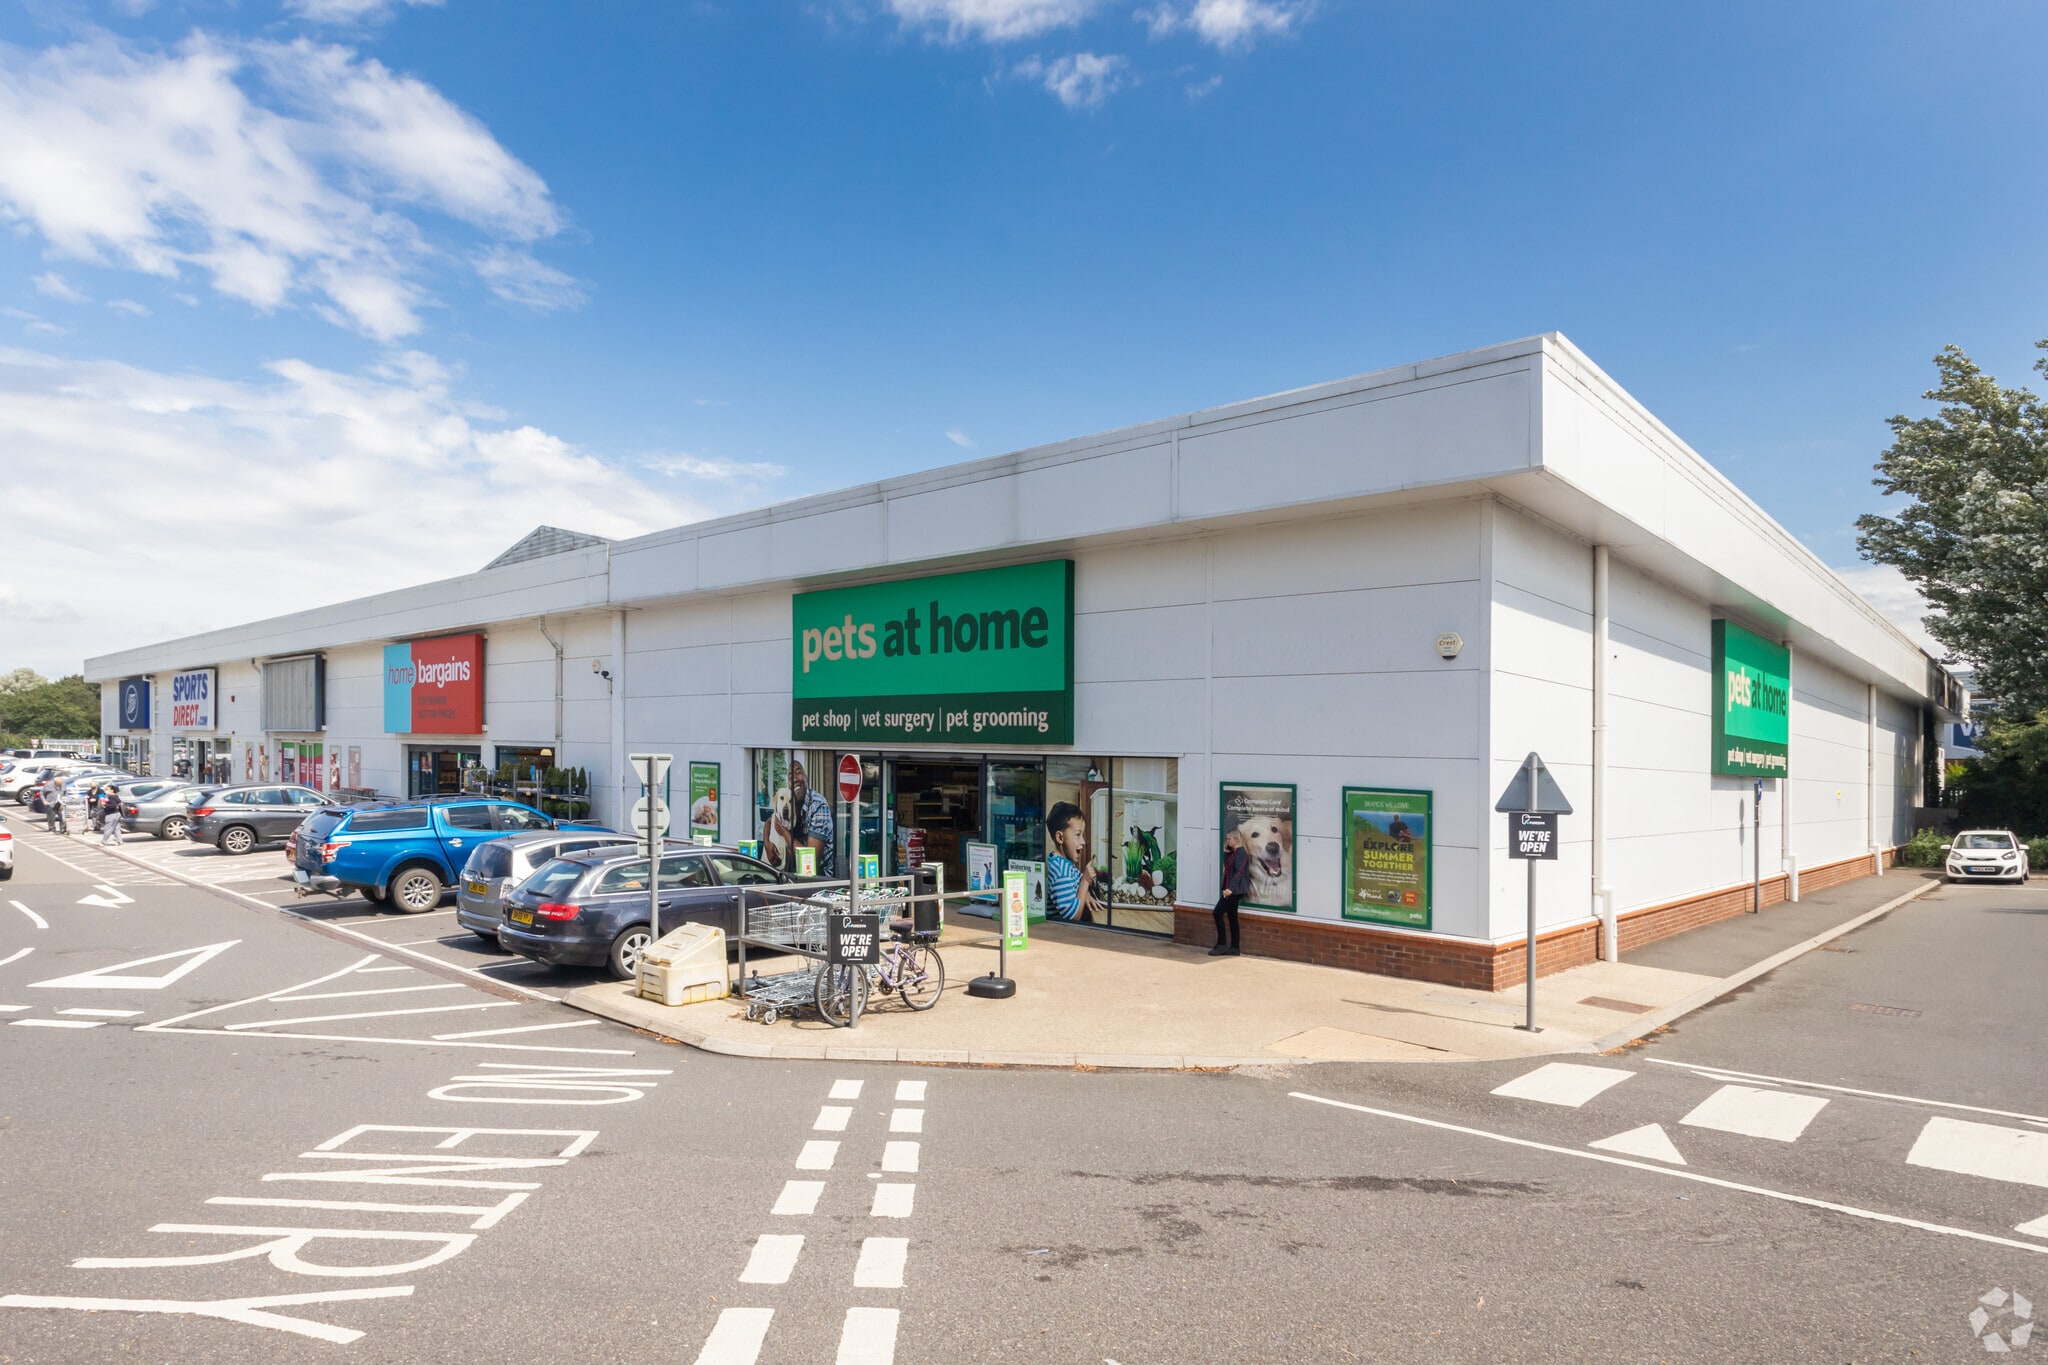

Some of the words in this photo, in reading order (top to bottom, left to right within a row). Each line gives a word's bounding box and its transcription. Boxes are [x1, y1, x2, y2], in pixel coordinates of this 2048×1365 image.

[802, 614, 877, 674] pets
[883, 607, 921, 657] at
[930, 600, 1049, 654] home
[387, 663, 414, 685] home
[418, 656, 471, 688] bargains
[173, 673, 208, 702] SPORTS
[1727, 666, 1751, 712] pets
[1751, 673, 1761, 709] at
[1762, 671, 1786, 717] home
[802, 710, 820, 732] pet
[823, 709, 851, 732] shop
[862, 710, 881, 728] vet
[884, 711, 935, 732] surgery
[946, 709, 969, 732] pet
[973, 707, 1049, 732] grooming
[1227, 804, 1251, 812] Complete
[1518, 830, 1551, 842] WE'RE
[1363, 840, 1414, 853] EXPLORE
[1520, 842, 1547, 853] OPEN
[1363, 850, 1414, 863] SUMMER
[1363, 859, 1414, 871] TOGETHER
[840, 934, 873, 945] WE'RE
[841, 945, 869, 957] OPEN
[426, 1063, 673, 1105] NO
[0, 1124, 600, 1344] ENTRY
